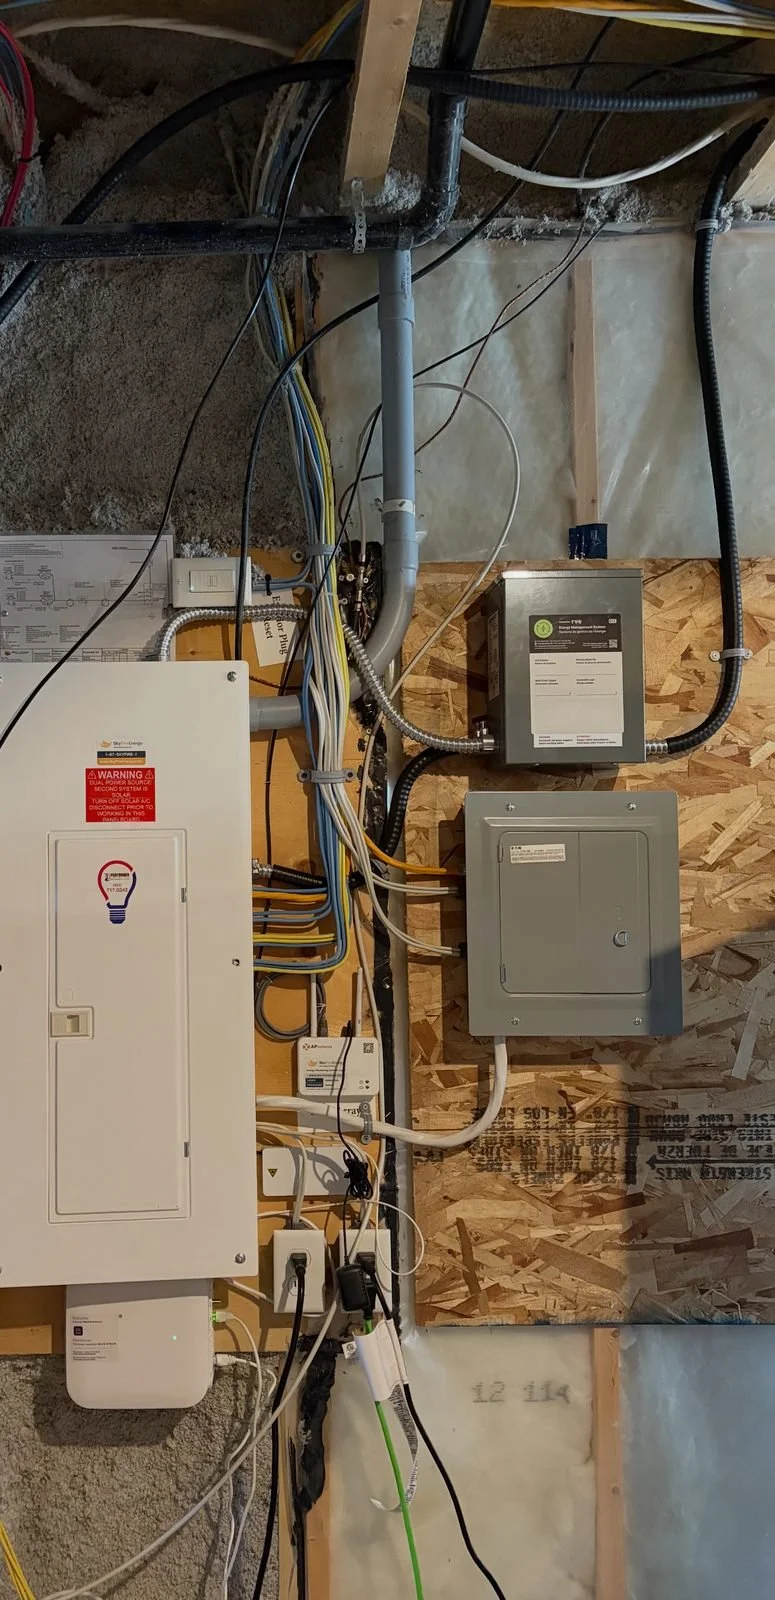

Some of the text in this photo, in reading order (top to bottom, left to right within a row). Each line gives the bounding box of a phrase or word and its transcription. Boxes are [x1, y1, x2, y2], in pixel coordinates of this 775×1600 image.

[278, 634, 288, 656] Plug
[97, 770, 143, 779] WARNING
[656, 1144, 774, 1158] EJE DE FUERZA
[698, 1166, 772, 1180] STRENGTH
[472, 1381, 504, 1402] 12
